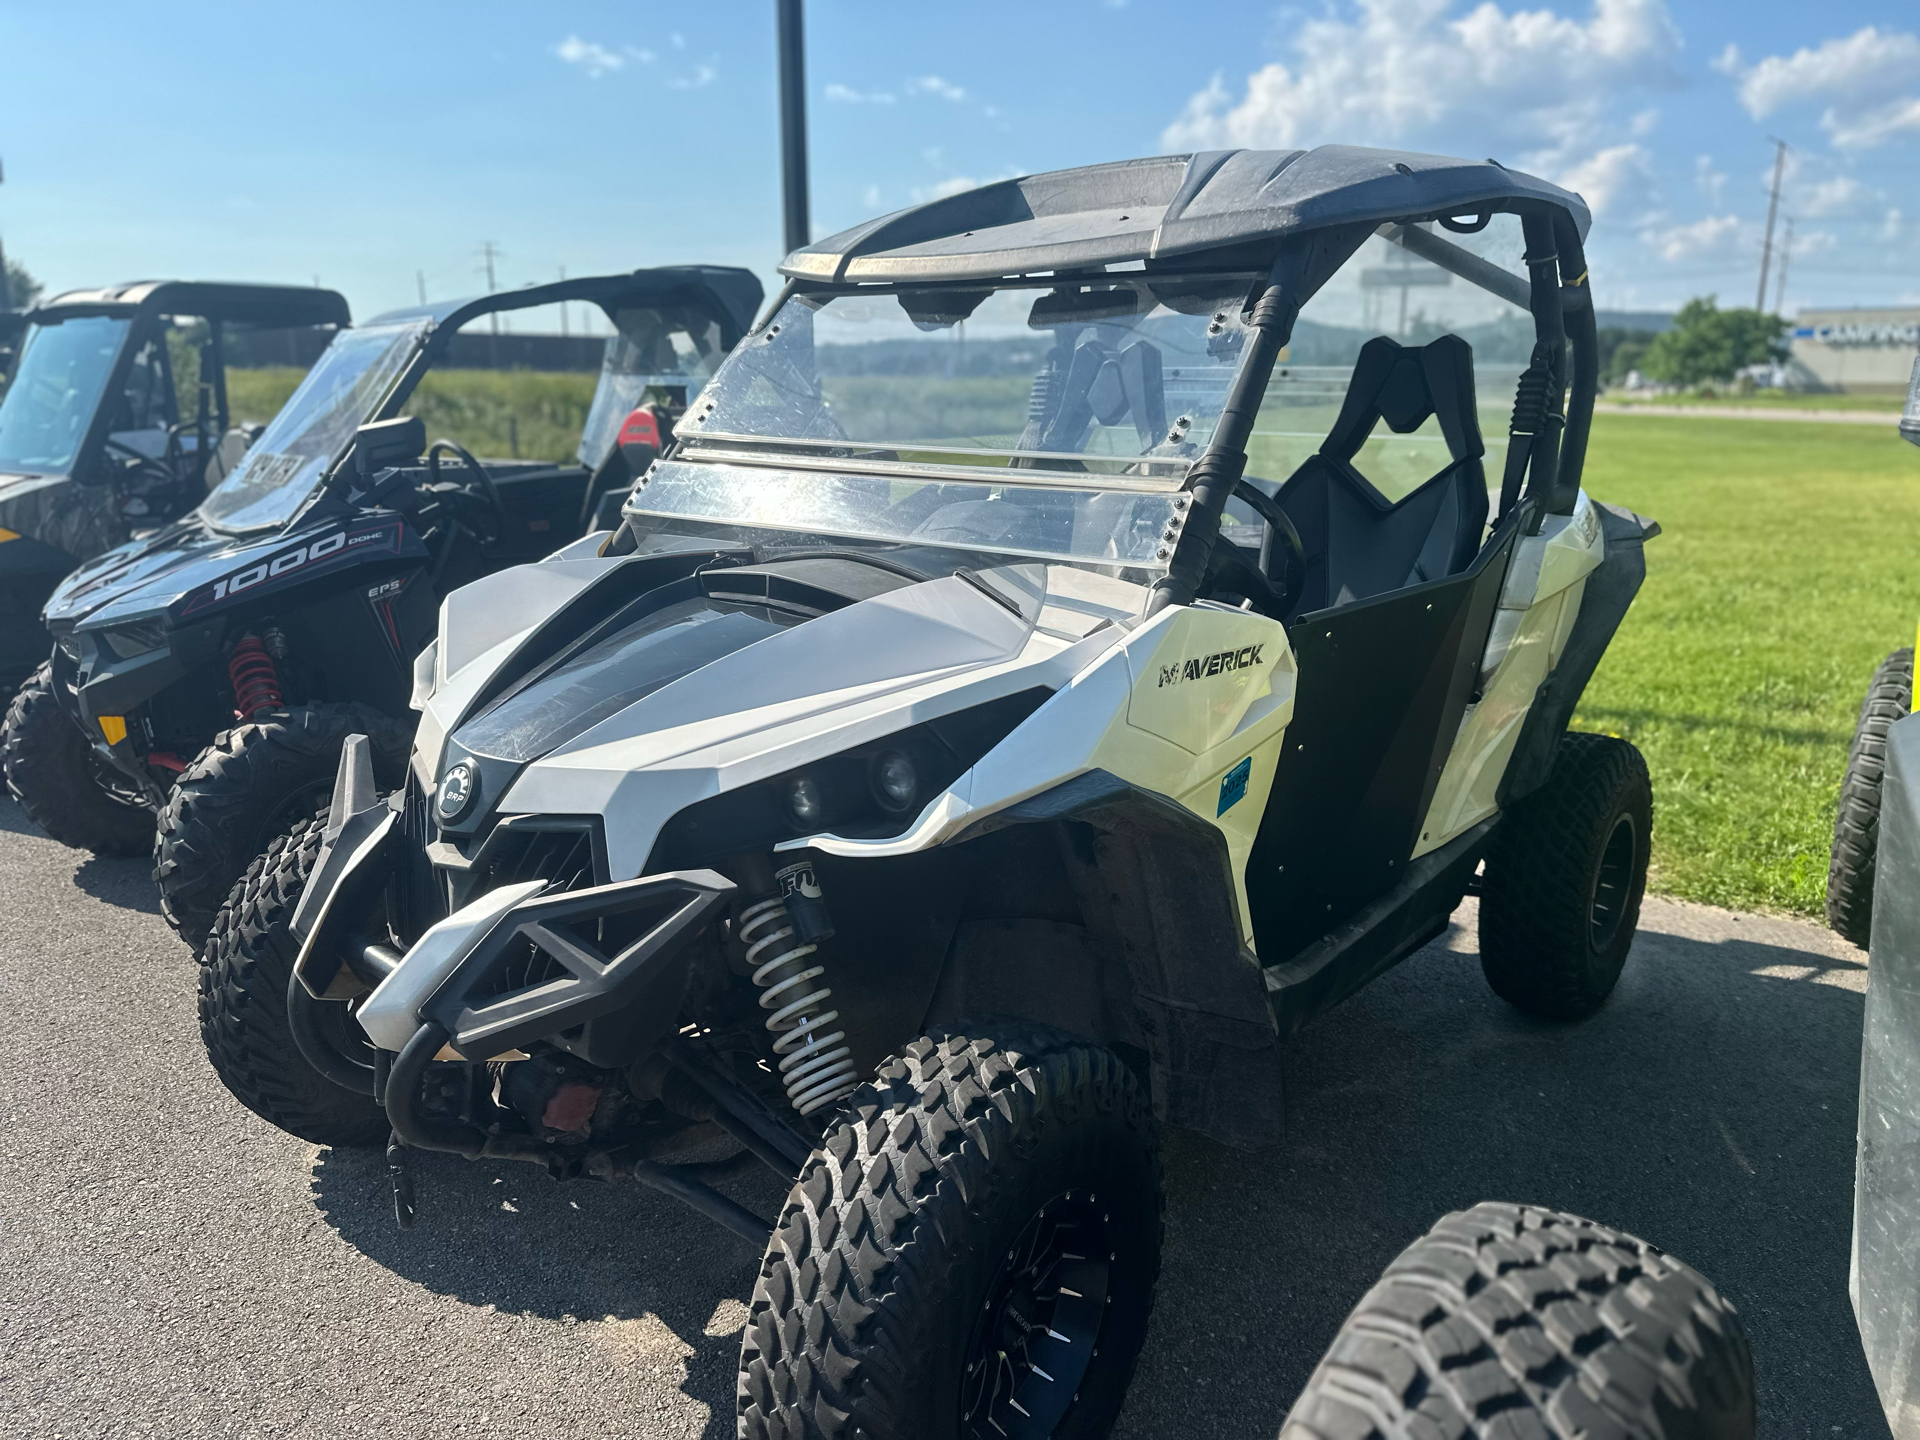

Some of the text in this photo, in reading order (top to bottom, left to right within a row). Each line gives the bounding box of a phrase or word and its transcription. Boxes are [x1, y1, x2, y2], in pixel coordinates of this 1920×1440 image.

[213, 531, 383, 601] 1000 DOHC
[368, 579, 400, 598] EPS
[1158, 643, 1265, 688] MAVERICK
[446, 791, 464, 802] BRP
[1221, 769, 1249, 801] 2025
[779, 867, 819, 899] FO
